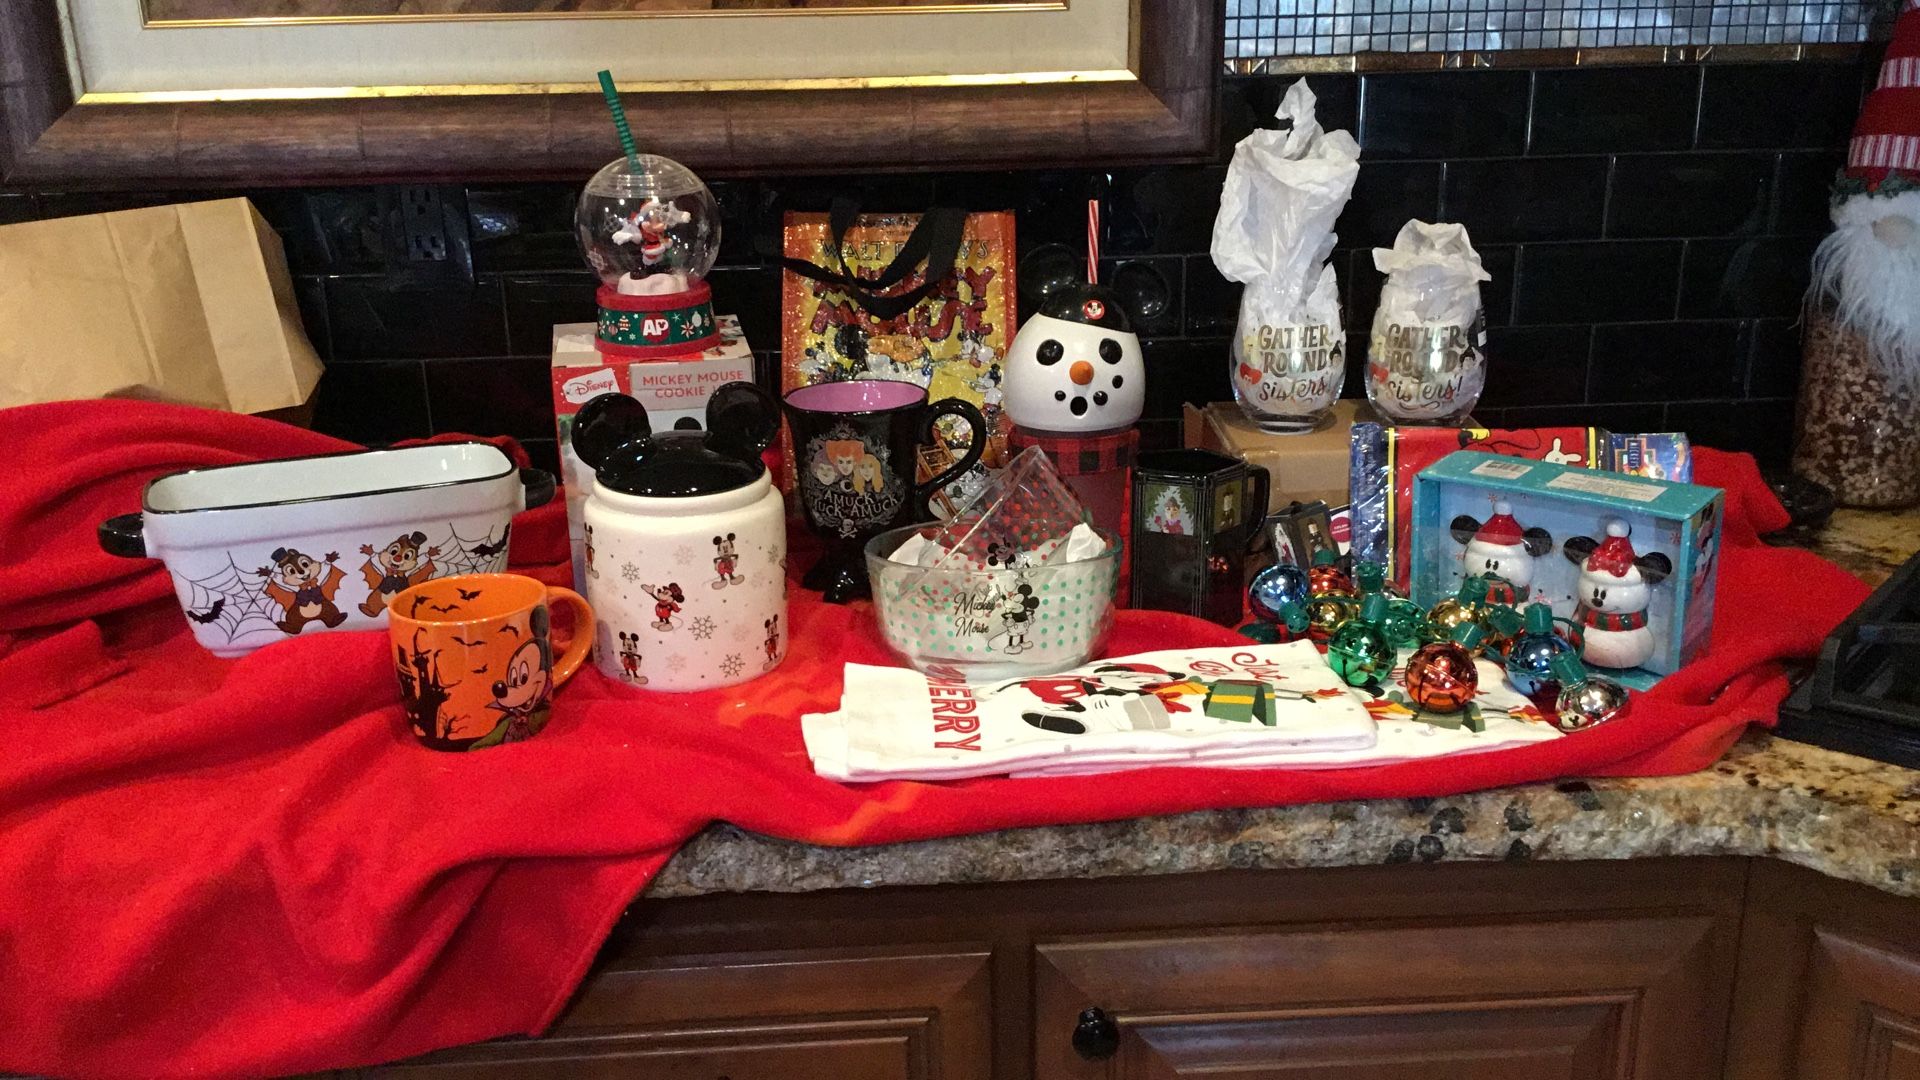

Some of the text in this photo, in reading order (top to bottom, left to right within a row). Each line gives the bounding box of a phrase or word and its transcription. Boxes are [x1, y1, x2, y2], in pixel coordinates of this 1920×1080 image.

[821, 240, 882, 261] WALT
[642, 318, 669, 337] AP
[1258, 324, 1333, 350] GATHER
[1386, 323, 1466, 350] GATHER
[642, 370, 744, 386] MICKEY MOUSE
[655, 386, 706, 399] COOKIE
[823, 489, 875, 508] AMUCK
[850, 493, 899, 518] AMUCK
[953, 591, 996, 616] Mickey
[954, 616, 990, 638] Mouse
